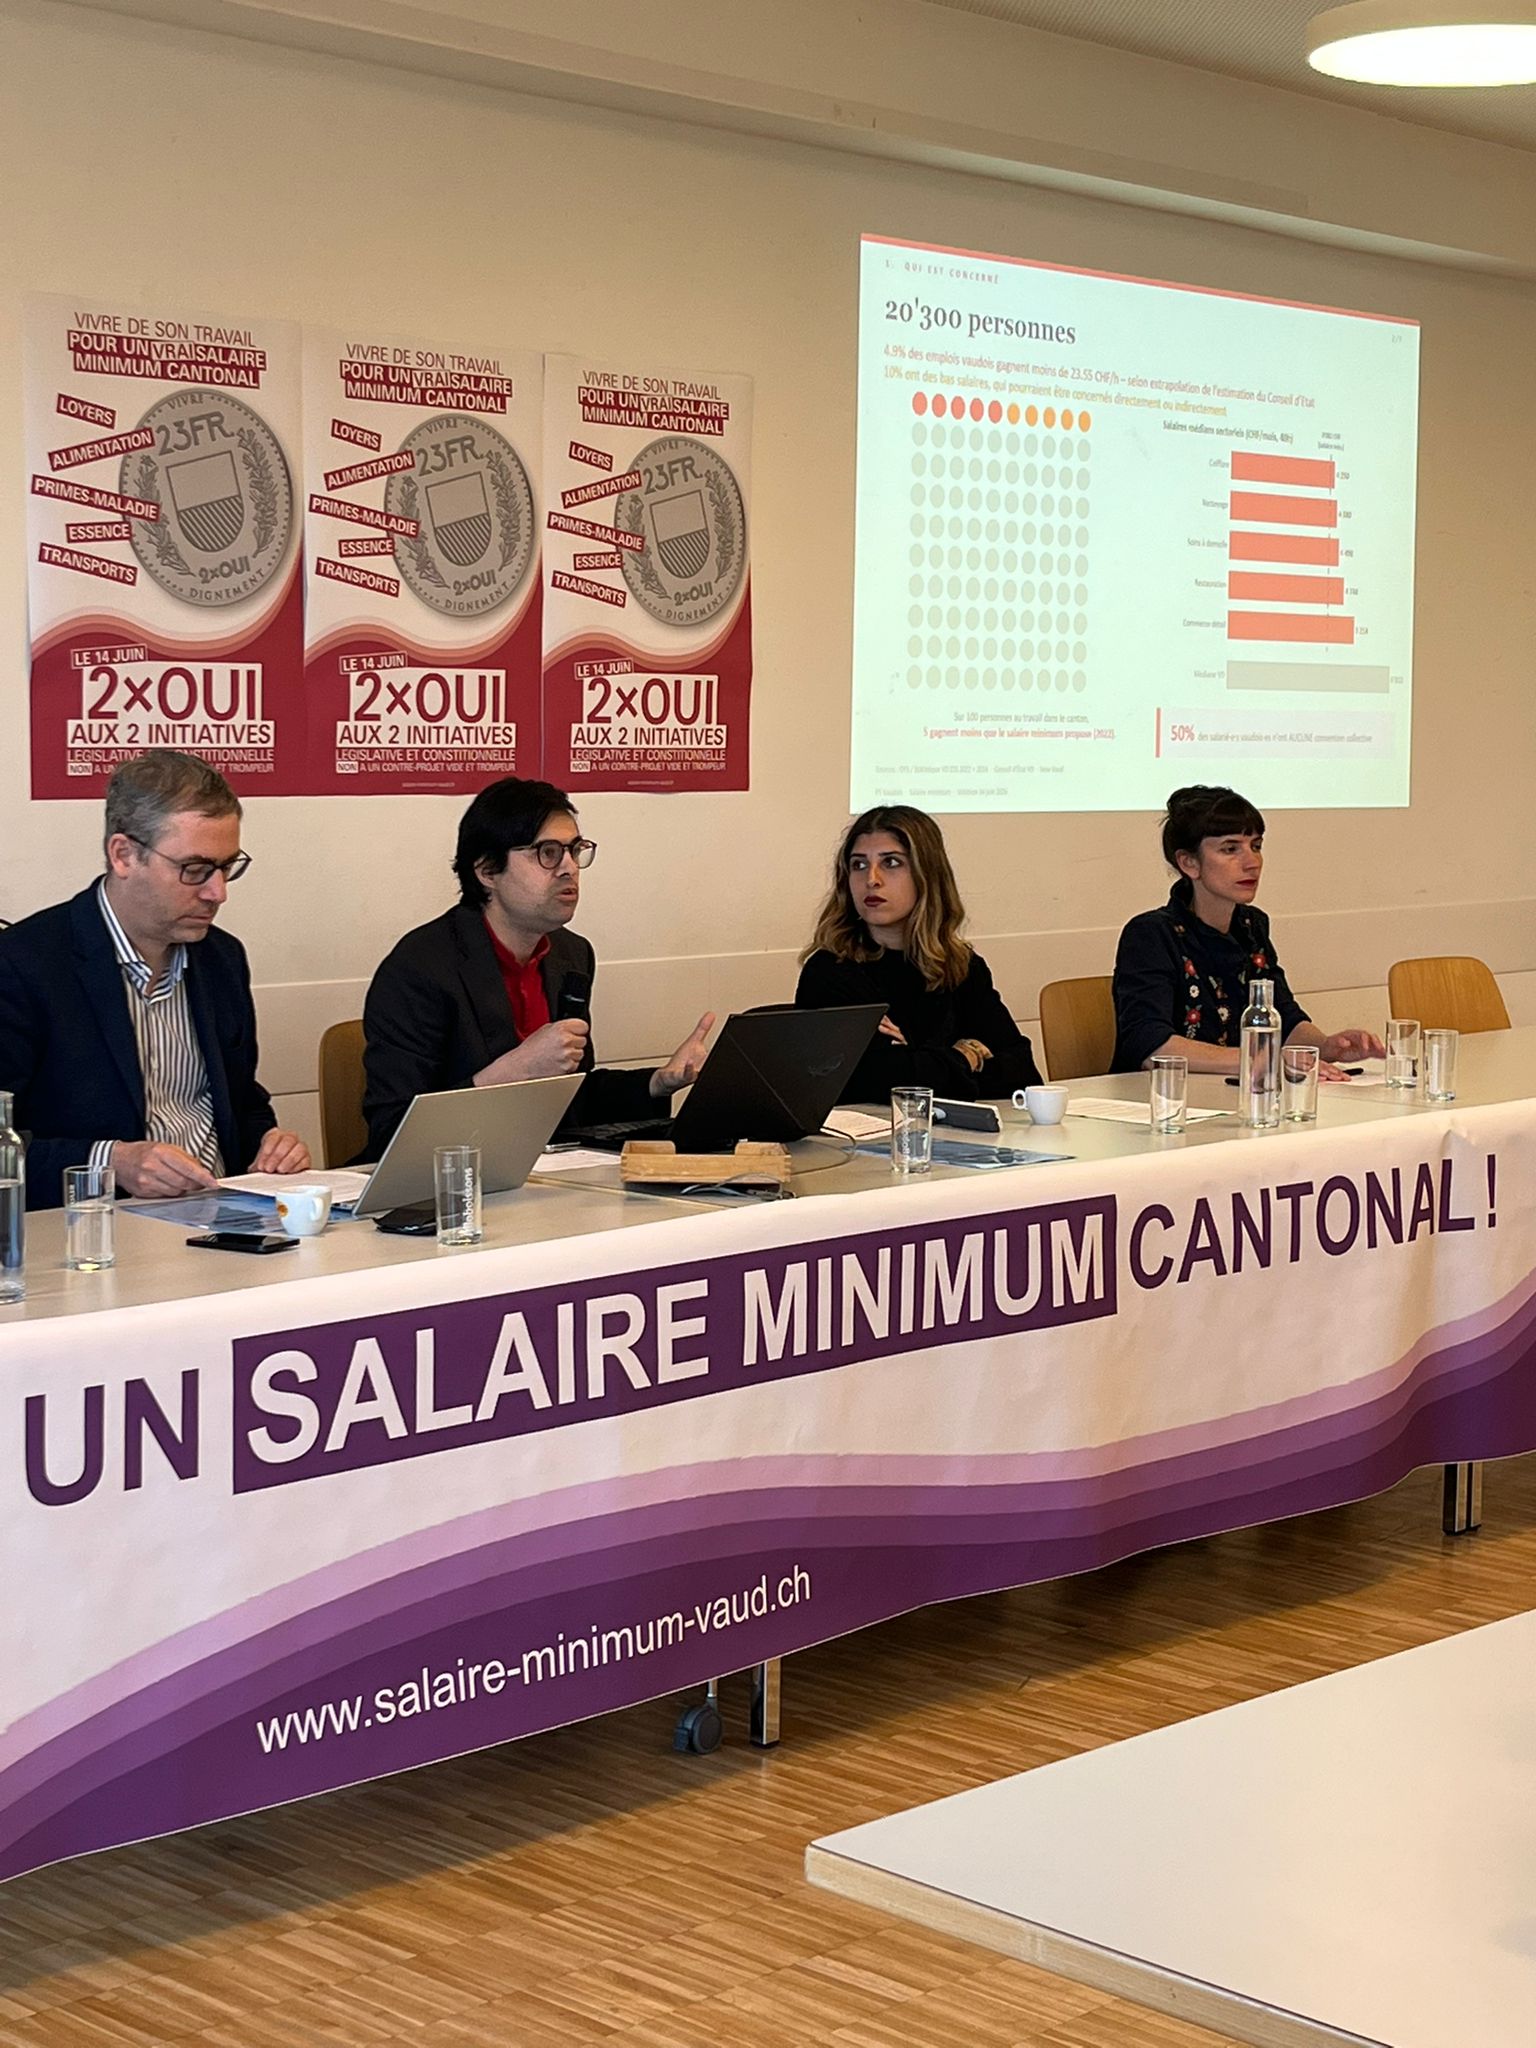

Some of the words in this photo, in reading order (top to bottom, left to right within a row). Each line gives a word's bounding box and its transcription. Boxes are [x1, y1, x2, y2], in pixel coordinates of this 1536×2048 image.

[904, 262, 922, 272] QUI
[928, 266, 944, 274] EST
[74, 312, 121, 332] VIVRE
[128, 318, 149, 336] DE
[155, 321, 188, 340] SON
[194, 325, 256, 348] TRAVAIL
[886, 297, 962, 330] 20'300
[967, 312, 1076, 344] personnes
[70, 332, 118, 352] POUR
[124, 338, 149, 356] UN
[152, 342, 194, 360] VRAI
[196, 346, 265, 368] SALAIRE
[346, 342, 388, 360] VIVRE
[394, 348, 411, 364] DE
[416, 351, 444, 368] SON
[450, 354, 504, 376] TRAVAIL
[76, 352, 161, 377] MINIMUM
[167, 362, 258, 387] CANTONAL
[342, 363, 384, 380] POUR
[388, 367, 410, 383] UN
[413, 371, 450, 388] VRAI
[450, 374, 511, 394] SALAIRE
[884, 344, 906, 360] 4.9%
[908, 347, 923, 361] des
[926, 351, 960, 366] emplois
[962, 355, 994, 369] vaudois
[996, 361, 1030, 374] gagnent
[1032, 364, 1056, 377] moins
[1058, 366, 1069, 379] de
[1070, 367, 1094, 381] 23.55
[1095, 371, 1120, 386] CHF/h
[1128, 375, 1148, 389] selon
[1150, 379, 1200, 395] extrapolation
[1202, 383, 1212, 395] de
[1213, 384, 1254, 400] l'estimation
[1256, 390, 1266, 402] du
[1268, 392, 1293, 406] Conseil
[347, 382, 420, 403] MINIMUM
[426, 390, 506, 412] CANTONAL
[582, 370, 618, 388] VIVRE
[623, 376, 639, 390] DE
[643, 378, 668, 394] SON
[672, 381, 720, 400] TRAVAIL
[884, 365, 902, 378] 10%
[905, 369, 920, 380] ont
[922, 370, 938, 383] des
[940, 372, 954, 385] bas
[957, 374, 991, 390] salaires,
[992, 380, 1006, 392] qui
[1008, 382, 1052, 396] pourraient
[1054, 384, 1070, 398] être
[1072, 388, 1112, 404] concernés
[1114, 392, 1161, 409] directement
[1163, 398, 1172, 410] ou
[1174, 399, 1226, 416] indirectement
[60, 397, 113, 426] LOYERS
[579, 388, 614, 406] POUR
[618, 393, 638, 408] UN
[641, 397, 673, 412] VRAI
[672, 398, 728, 418] SALAIRE
[334, 422, 379, 448] LOYERS
[584, 407, 648, 426] MINIMUM
[652, 414, 722, 434] CANTONAL
[52, 430, 152, 468] ALIMENTATION
[571, 444, 611, 468] LOYERS
[328, 454, 412, 488] ALIMENTATION
[35, 478, 158, 519] PRIMES-MALADIE
[564, 474, 640, 506] ALIMENTATION
[312, 498, 416, 535] PRIMES-MALADIE
[550, 514, 643, 548] PRIMES-MALADIE
[68, 524, 130, 540] ESSENCE
[341, 540, 392, 554] ESSENCE
[575, 553, 621, 568] ESSENCE
[42, 546, 135, 582] TRANSPORTS
[318, 561, 398, 594] TRANSPORTS
[190, 568, 264, 600] DIGNEMENT
[445, 581, 510, 610] DIGNEMENT
[554, 573, 624, 604] TRANSPORTS
[666, 592, 724, 620] DIGNEMENT
[74, 653, 91, 666] LE
[96, 651, 110, 664] 14
[112, 648, 144, 662] JUIN
[342, 660, 358, 671] LE
[361, 658, 374, 670] 14
[377, 655, 404, 668] JUIN
[577, 666, 590, 677] LE
[593, 664, 604, 676] 14
[606, 662, 632, 674] JUIN
[954, 712, 966, 722] Sur
[967, 713, 978, 722] 100
[980, 714, 1012, 724] personnes
[1023, 712, 1042, 723] travail
[1044, 714, 1058, 723] dans
[1059, 714, 1064, 723] le
[71, 724, 119, 744] AUX
[128, 724, 139, 744] 2
[150, 724, 271, 744] INITIATIVES
[340, 725, 381, 744] AUX
[389, 725, 398, 744] 2
[408, 726, 512, 744] INITIATIVES
[574, 727, 612, 745] AUX
[618, 728, 628, 745] 2
[634, 728, 724, 745] INITIATIVES
[1170, 725, 1195, 742] 50%
[70, 764, 92, 774] NON
[228, 763, 274, 773] TROMPEUR
[338, 762, 356, 772] NON
[368, 762, 380, 772] UN
[383, 762, 446, 772] CONTRE-PROJET
[448, 762, 464, 772] VIDE
[465, 762, 474, 772] ET
[476, 762, 516, 772] TROMPEUR
[406, 750, 418, 761] ET
[599, 762, 610, 770] UN
[611, 762, 666, 771] CONTRE-PROJET
[667, 762, 681, 770] VIDE
[683, 762, 692, 770] ET
[692, 762, 726, 771] TROMPEUR
[634, 750, 645, 760] ET
[25, 1368, 199, 1506] UN
[247, 1278, 709, 1464] SALAIRE
[742, 1213, 1104, 1367] MINIMUM
[256, 1563, 812, 1754] www.salaire-minimum-vaud.ch
